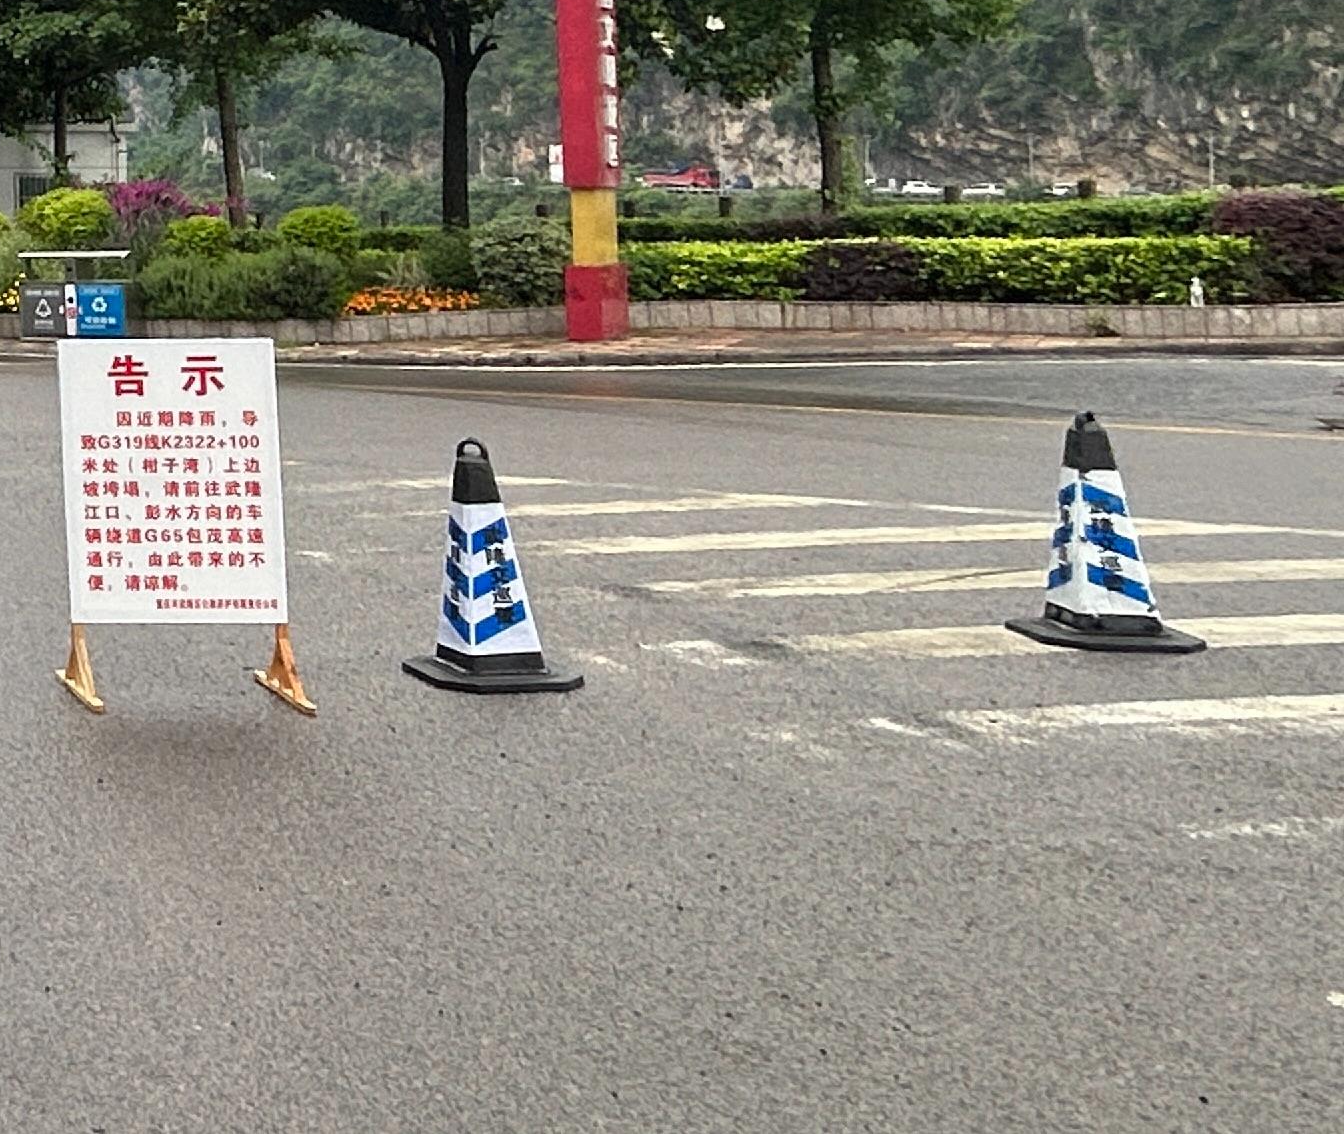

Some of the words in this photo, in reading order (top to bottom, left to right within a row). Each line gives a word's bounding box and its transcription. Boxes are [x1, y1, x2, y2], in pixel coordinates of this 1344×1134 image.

[107, 354, 226, 397] 告示
[80, 434, 260, 451] 致G319线K2322+100
[84, 504, 263, 522] 江口、彭水方向的车
[84, 527, 264, 544] 辆绕道G65包茂高速
